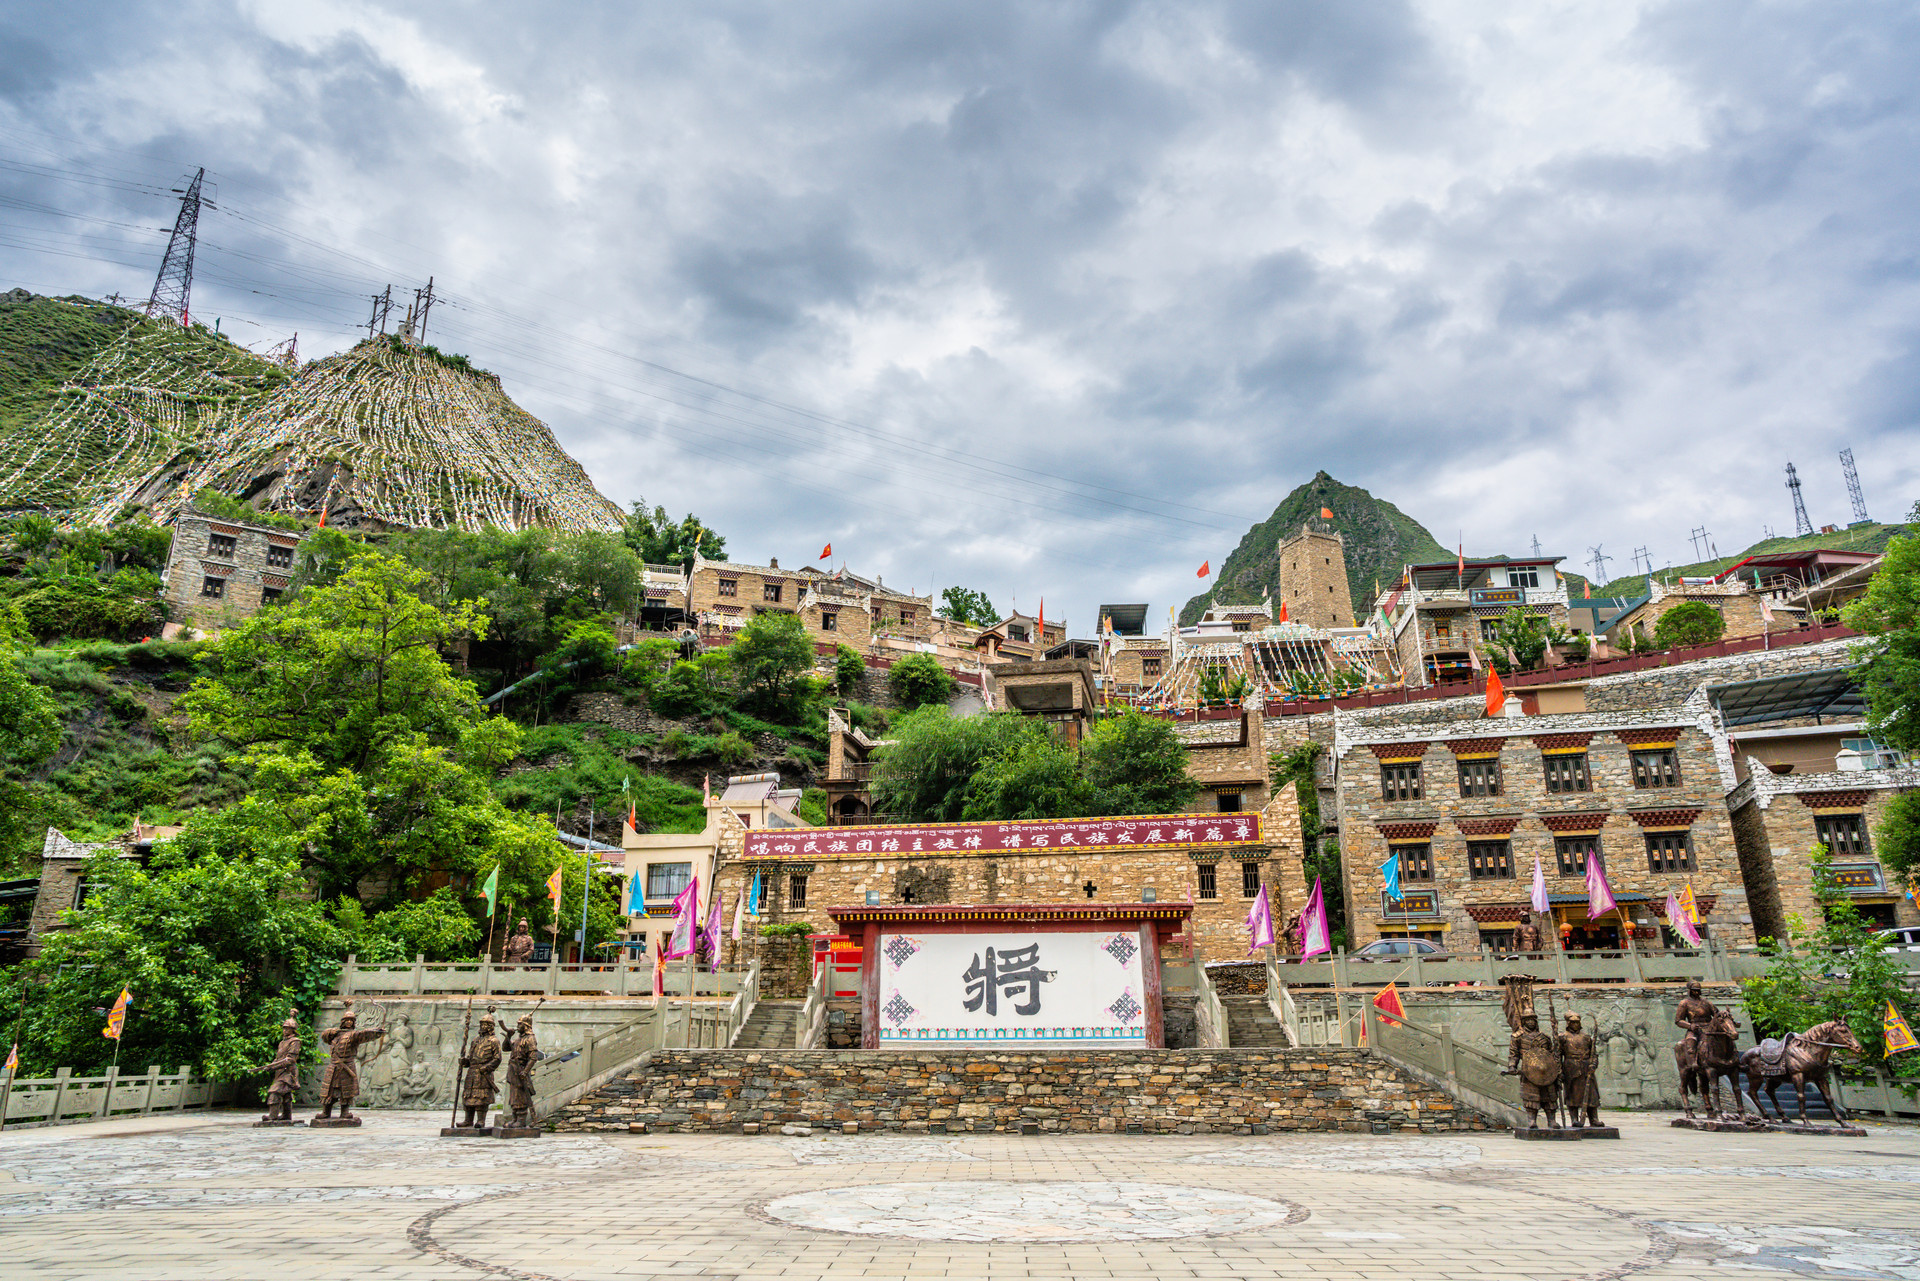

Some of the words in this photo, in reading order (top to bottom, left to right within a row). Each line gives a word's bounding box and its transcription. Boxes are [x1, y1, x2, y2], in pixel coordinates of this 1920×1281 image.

[750, 835, 982, 855] 唱响民族团结主旋律
[1001, 825, 1253, 848] 谱写民族发展新篇章
